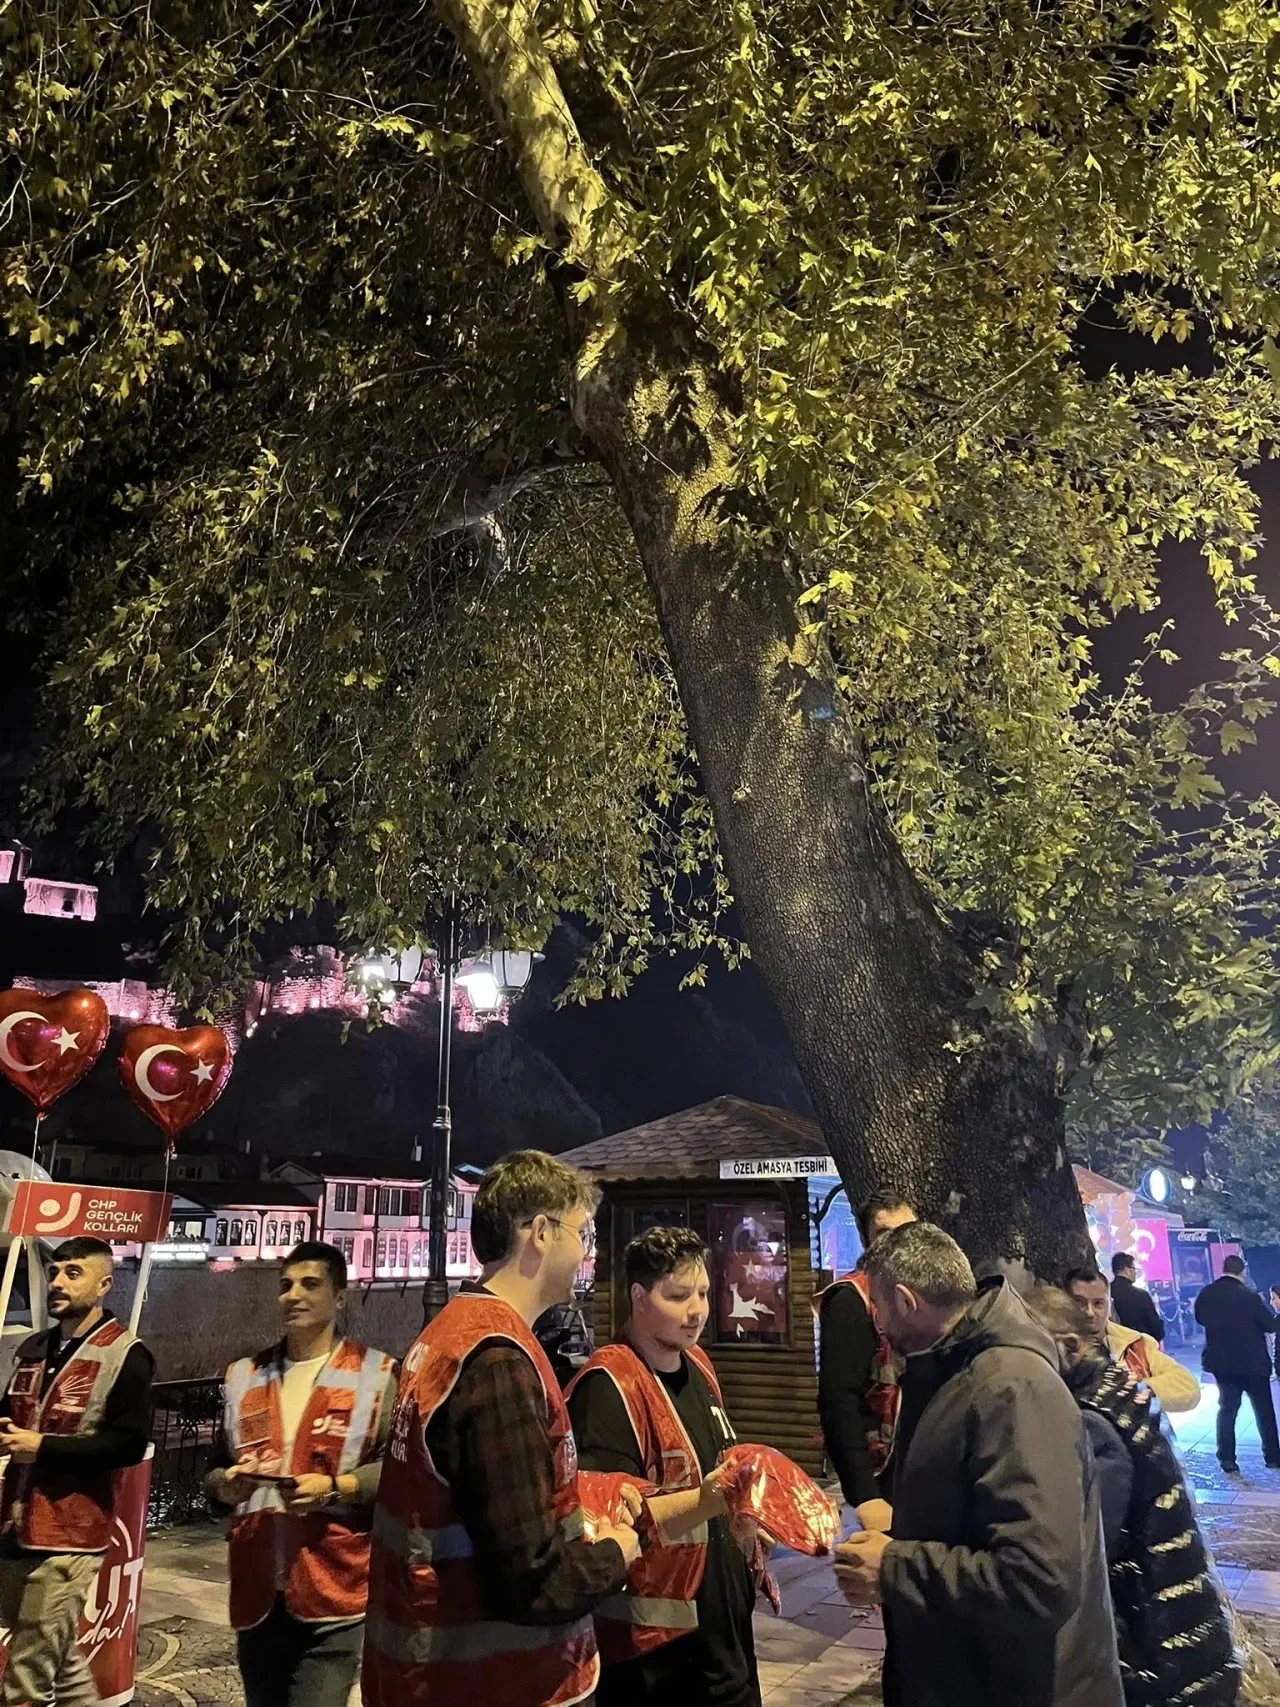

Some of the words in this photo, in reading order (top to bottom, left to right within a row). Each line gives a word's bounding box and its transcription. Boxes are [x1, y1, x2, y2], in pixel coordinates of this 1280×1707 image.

[733, 1160, 755, 1175] ÖZEL
[756, 1161, 792, 1174] AMASYA
[794, 1158, 828, 1173] TESBİHİ
[88, 1199, 117, 1209] CHP
[86, 1210, 143, 1223] GENÇLİK
[83, 1222, 139, 1234] KOLLARI
[84, 1557, 143, 1623] UT
[75, 1601, 132, 1645] da!
